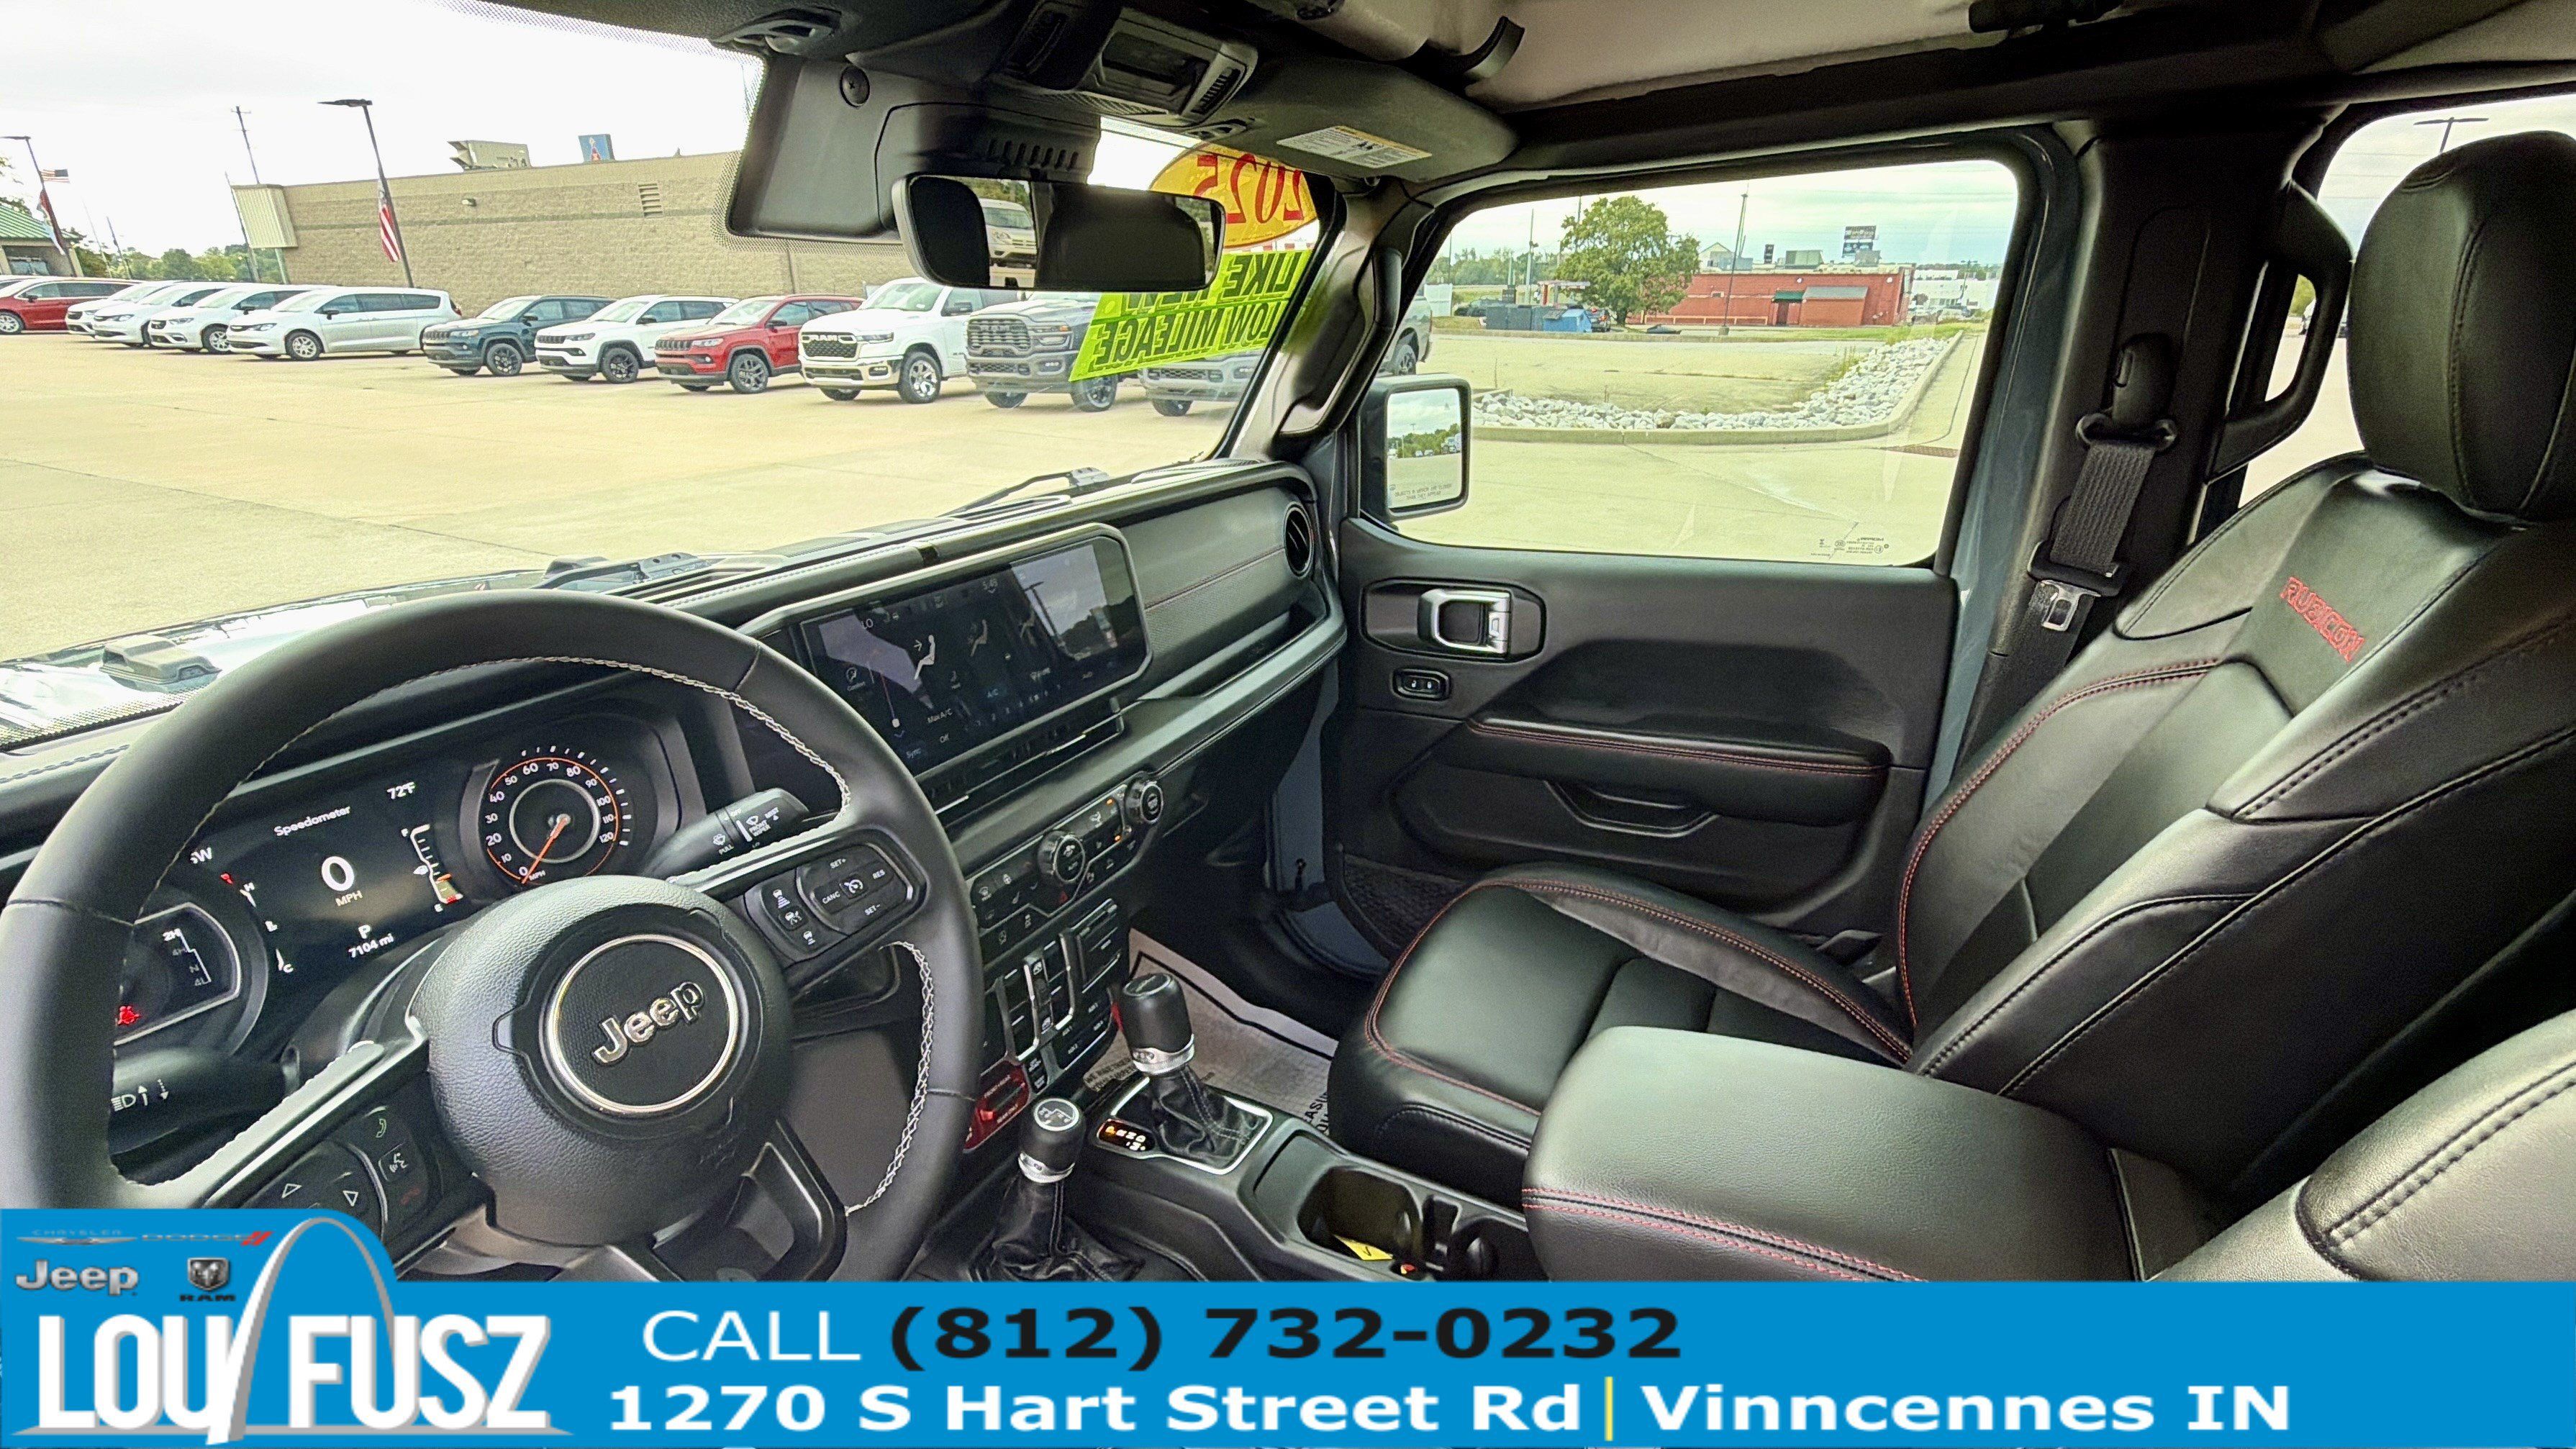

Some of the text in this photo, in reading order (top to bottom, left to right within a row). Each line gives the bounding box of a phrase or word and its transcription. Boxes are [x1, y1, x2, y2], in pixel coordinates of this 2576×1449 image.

[2280, 576, 2365, 663] RUBICON
[522, 763, 539, 776] 60
[546, 762, 559, 771] 70
[566, 766, 581, 778] 80
[504, 775, 518, 786] 50
[585, 778, 598, 789] 90
[489, 791, 505, 803] 40
[597, 795, 612, 807] 100
[274, 806, 351, 836] Speedometer
[485, 812, 499, 825] 30
[602, 813, 614, 825] 110
[485, 832, 502, 847] 20
[599, 831, 614, 844] 120
[501, 853, 512, 863] 10
[321, 855, 355, 891] 0
[518, 866, 529, 876] 0
[335, 890, 363, 907] MPH
[822, 891, 841, 904] CANC
[358, 924, 371, 939] P
[348, 932, 395, 958] 7104 mi
[283, 963, 294, 973] C
[591, 981, 705, 1064] Jeep
